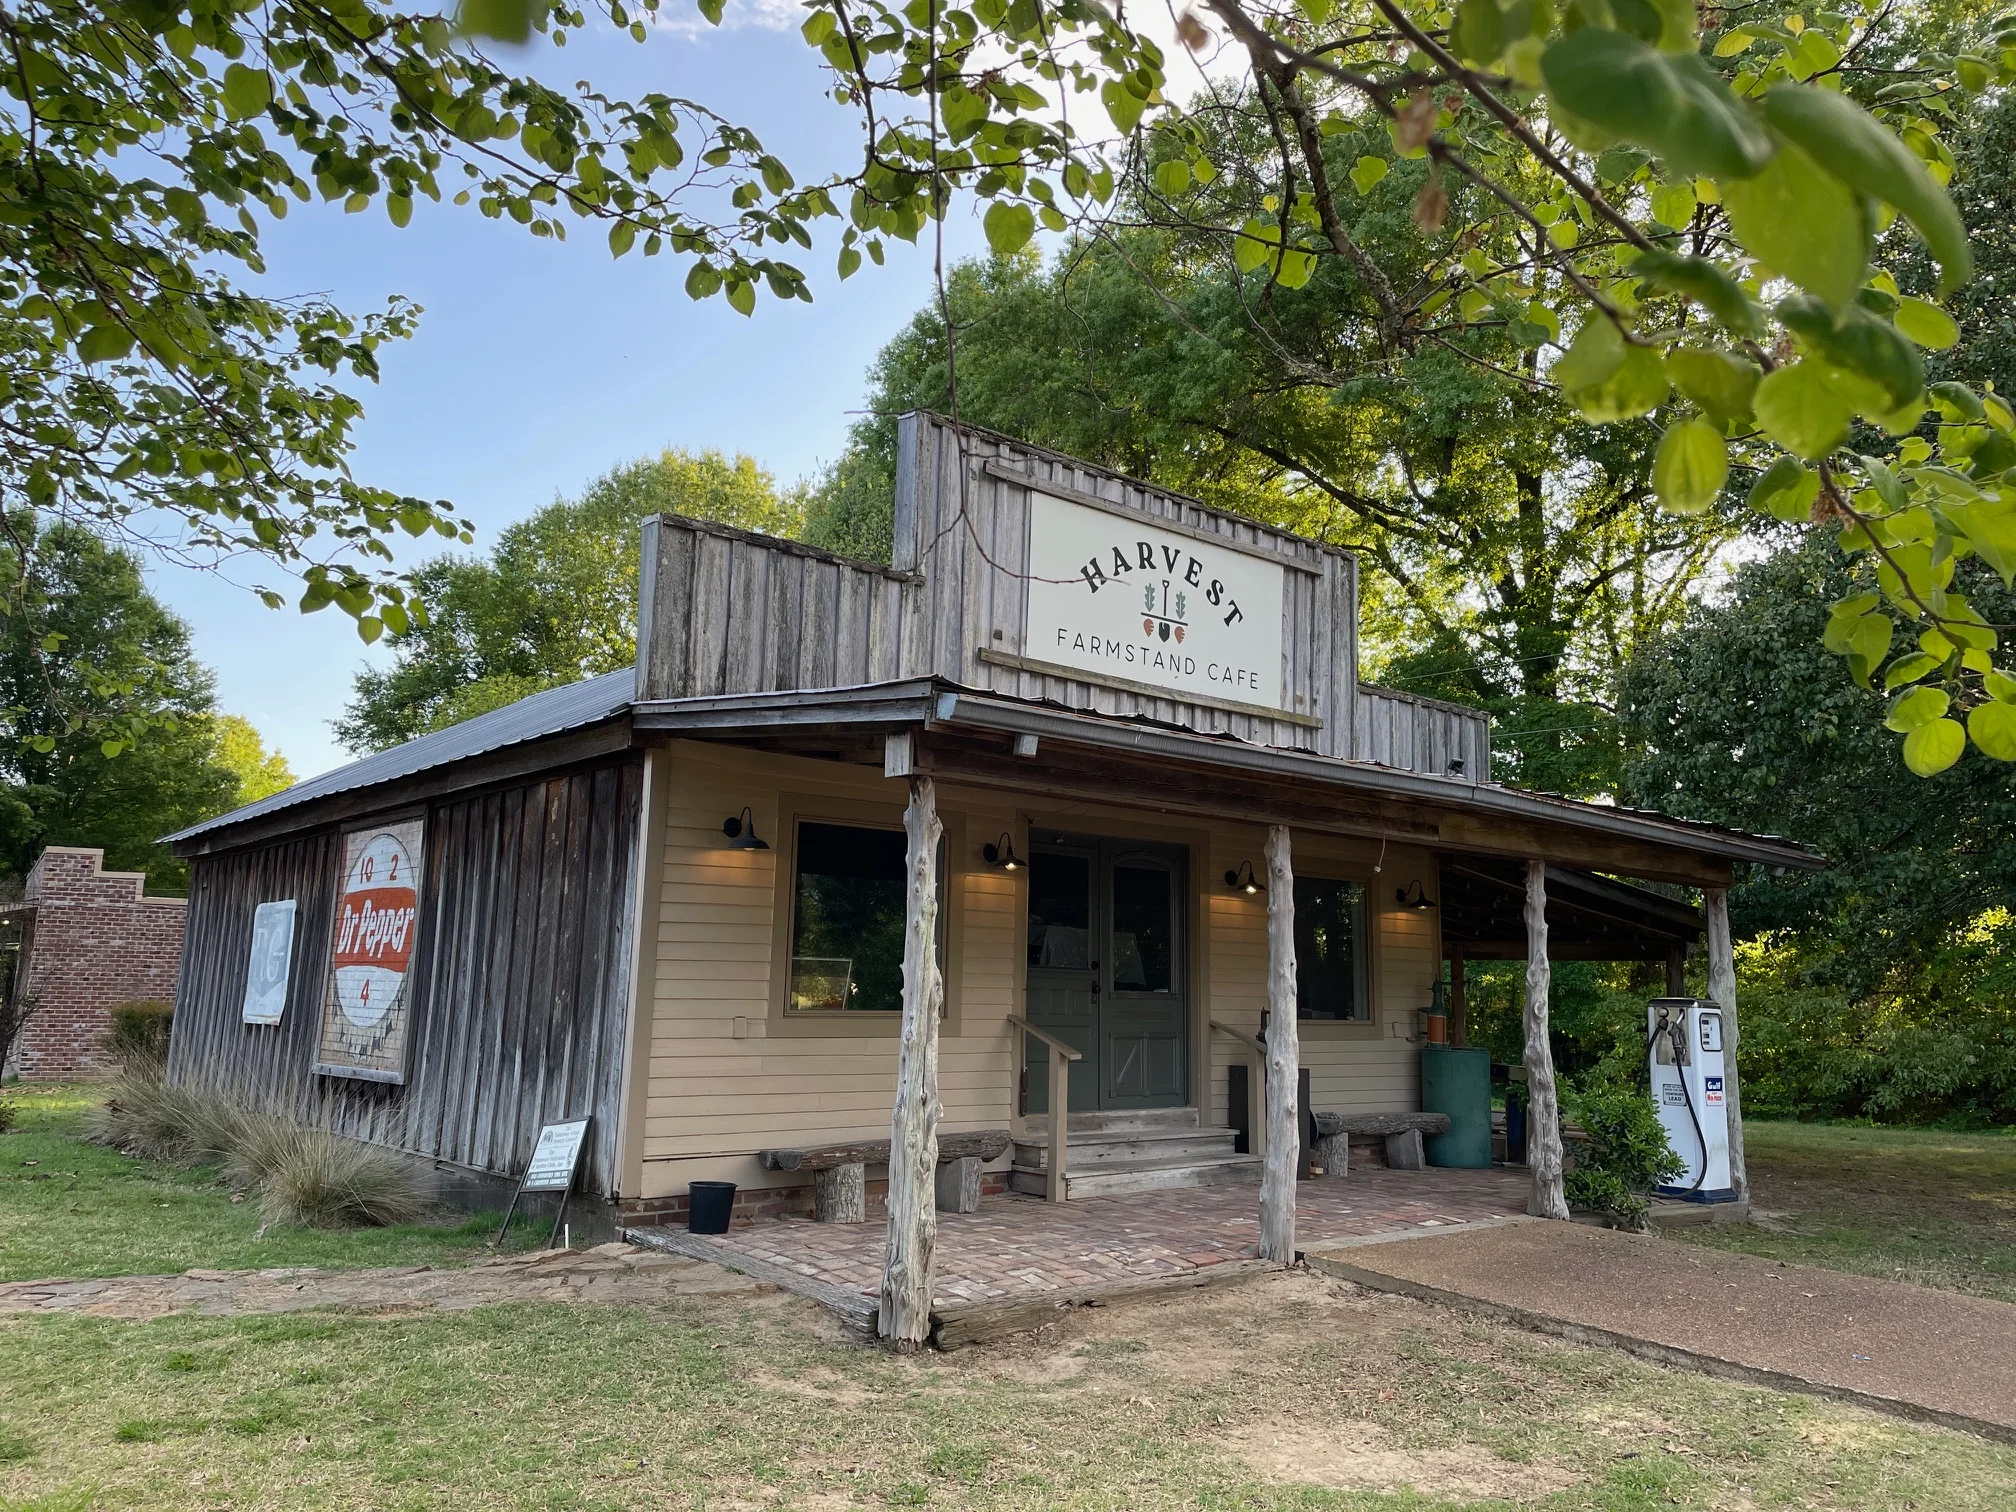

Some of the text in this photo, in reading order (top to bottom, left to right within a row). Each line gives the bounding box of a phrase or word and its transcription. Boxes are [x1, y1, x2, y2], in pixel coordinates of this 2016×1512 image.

[1080, 541, 1243, 627] HARVEST
[1057, 628, 1259, 690] FARMSTAND CAFE
[360, 854, 399, 884] 10 2
[337, 899, 415, 958] Dr Pepper
[360, 979, 369, 1007] 4
[1707, 1081, 1721, 1090] Gulf
